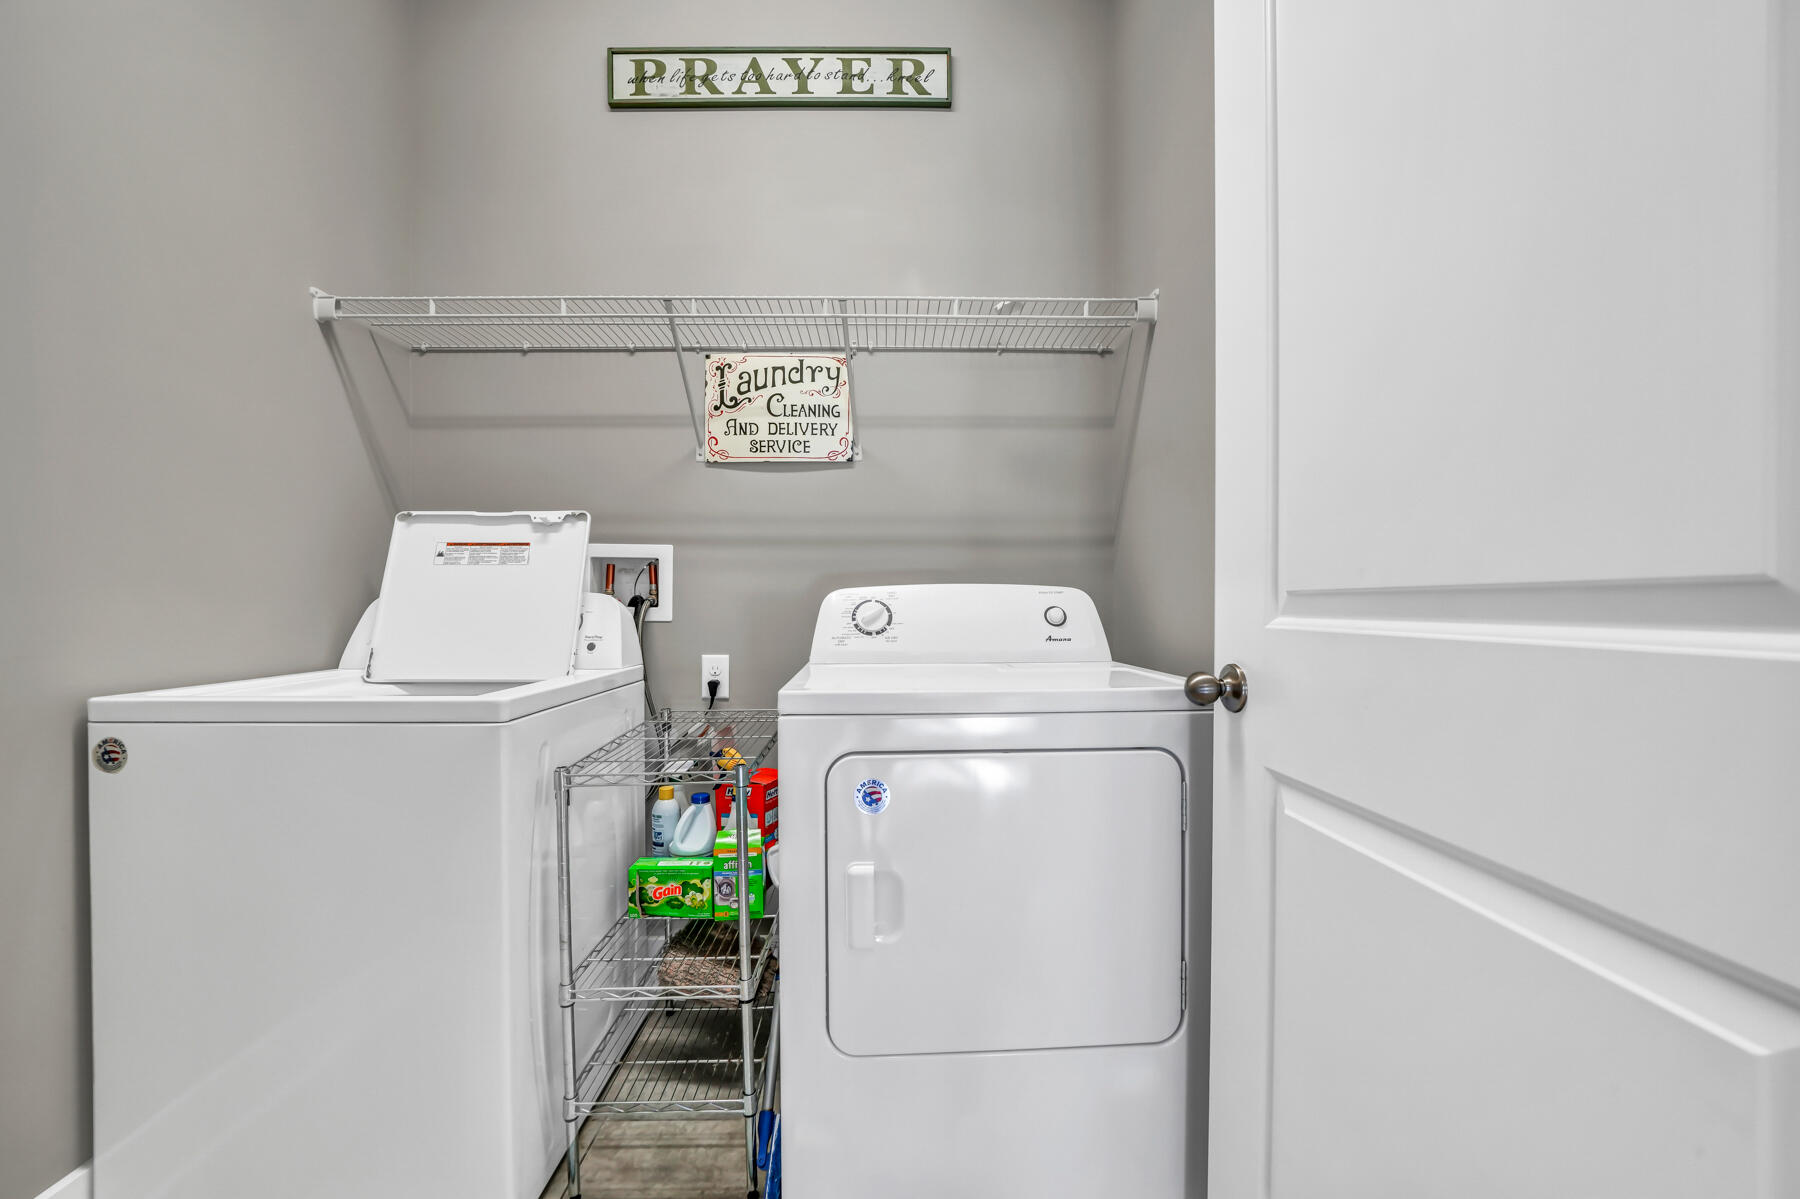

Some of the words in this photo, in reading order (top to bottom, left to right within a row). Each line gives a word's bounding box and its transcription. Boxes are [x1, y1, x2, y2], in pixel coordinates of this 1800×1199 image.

[627, 70, 664, 84] when
[669, 68, 697, 88] life
[697, 69, 737, 88] gets
[740, 70, 762, 82] too
[765, 67, 806, 81] hard
[806, 67, 821, 80] to
[629, 56, 932, 96] PRAYER
[713, 359, 841, 411] Laundry
[766, 393, 841, 418] CLEANING
[724, 418, 759, 436] AND
[768, 422, 838, 436] DELIVERY
[749, 439, 811, 454] SERVICE
[856, 779, 888, 794] AMERICA
[652, 884, 682, 900] Gain
